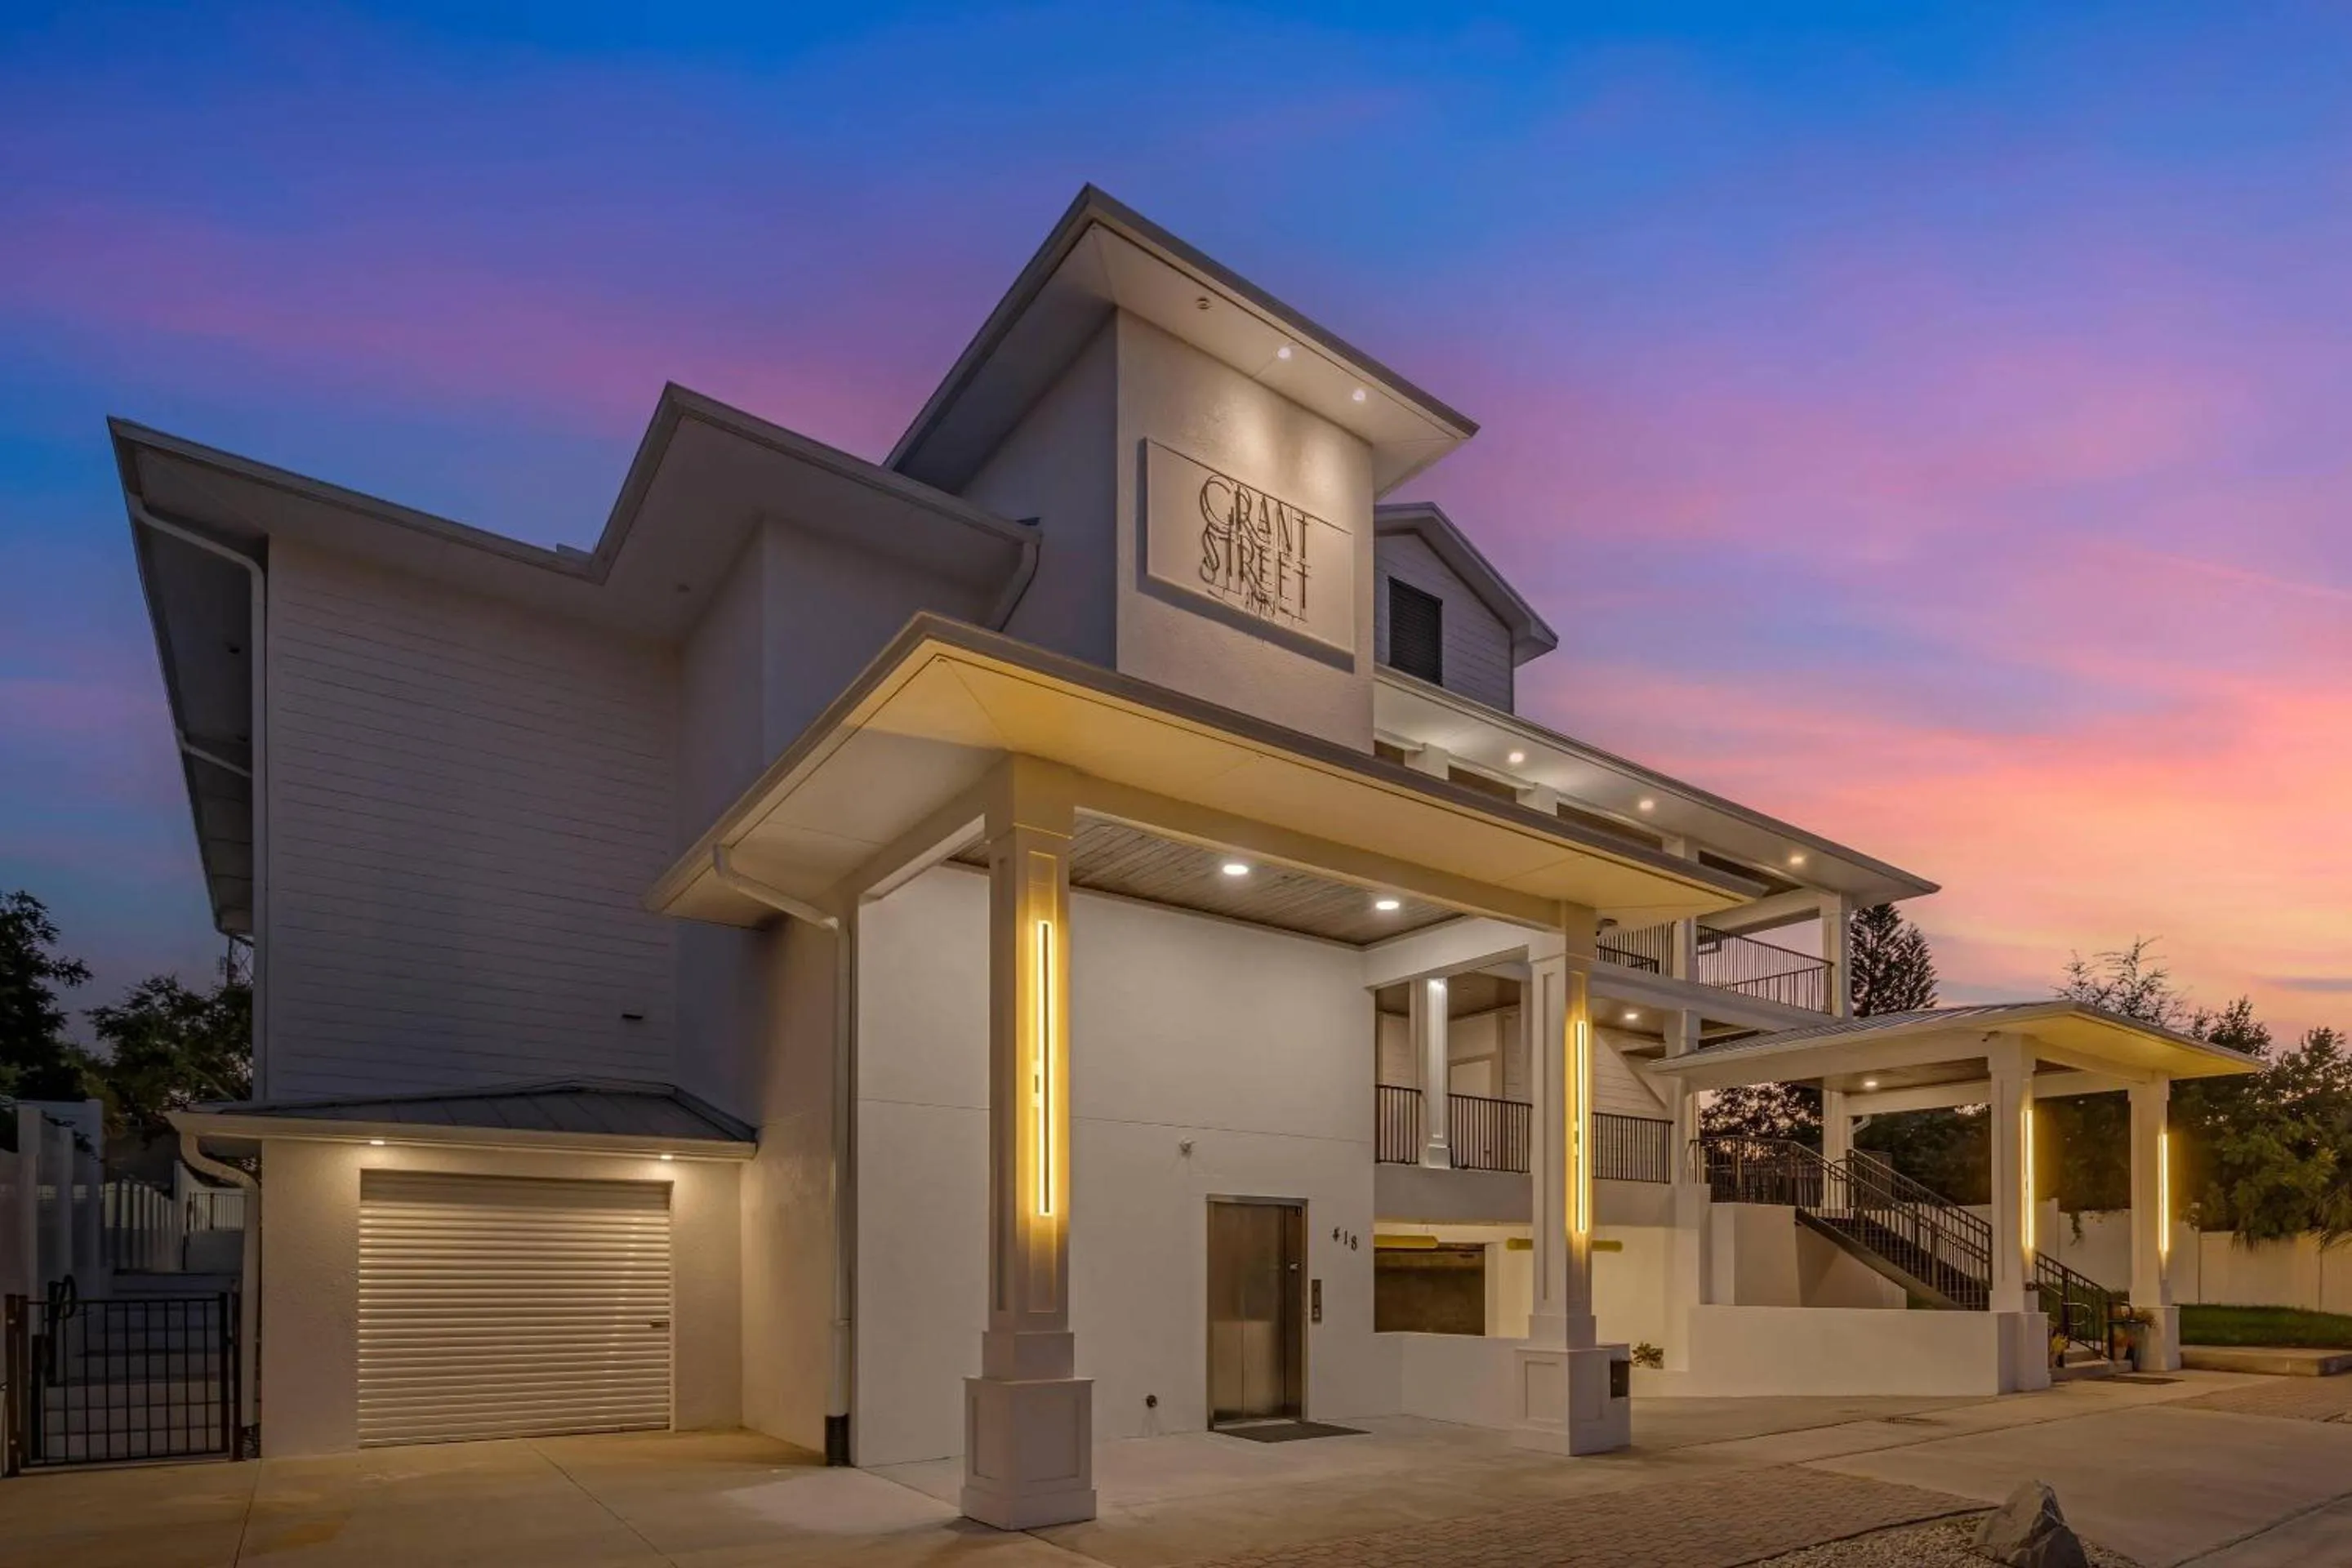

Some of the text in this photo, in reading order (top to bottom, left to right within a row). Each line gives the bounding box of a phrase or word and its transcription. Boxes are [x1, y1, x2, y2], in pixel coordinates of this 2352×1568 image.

[1200, 474, 1308, 559] GRANT
[1200, 526, 1312, 611] STREET
[1332, 1227, 1357, 1251] 418
